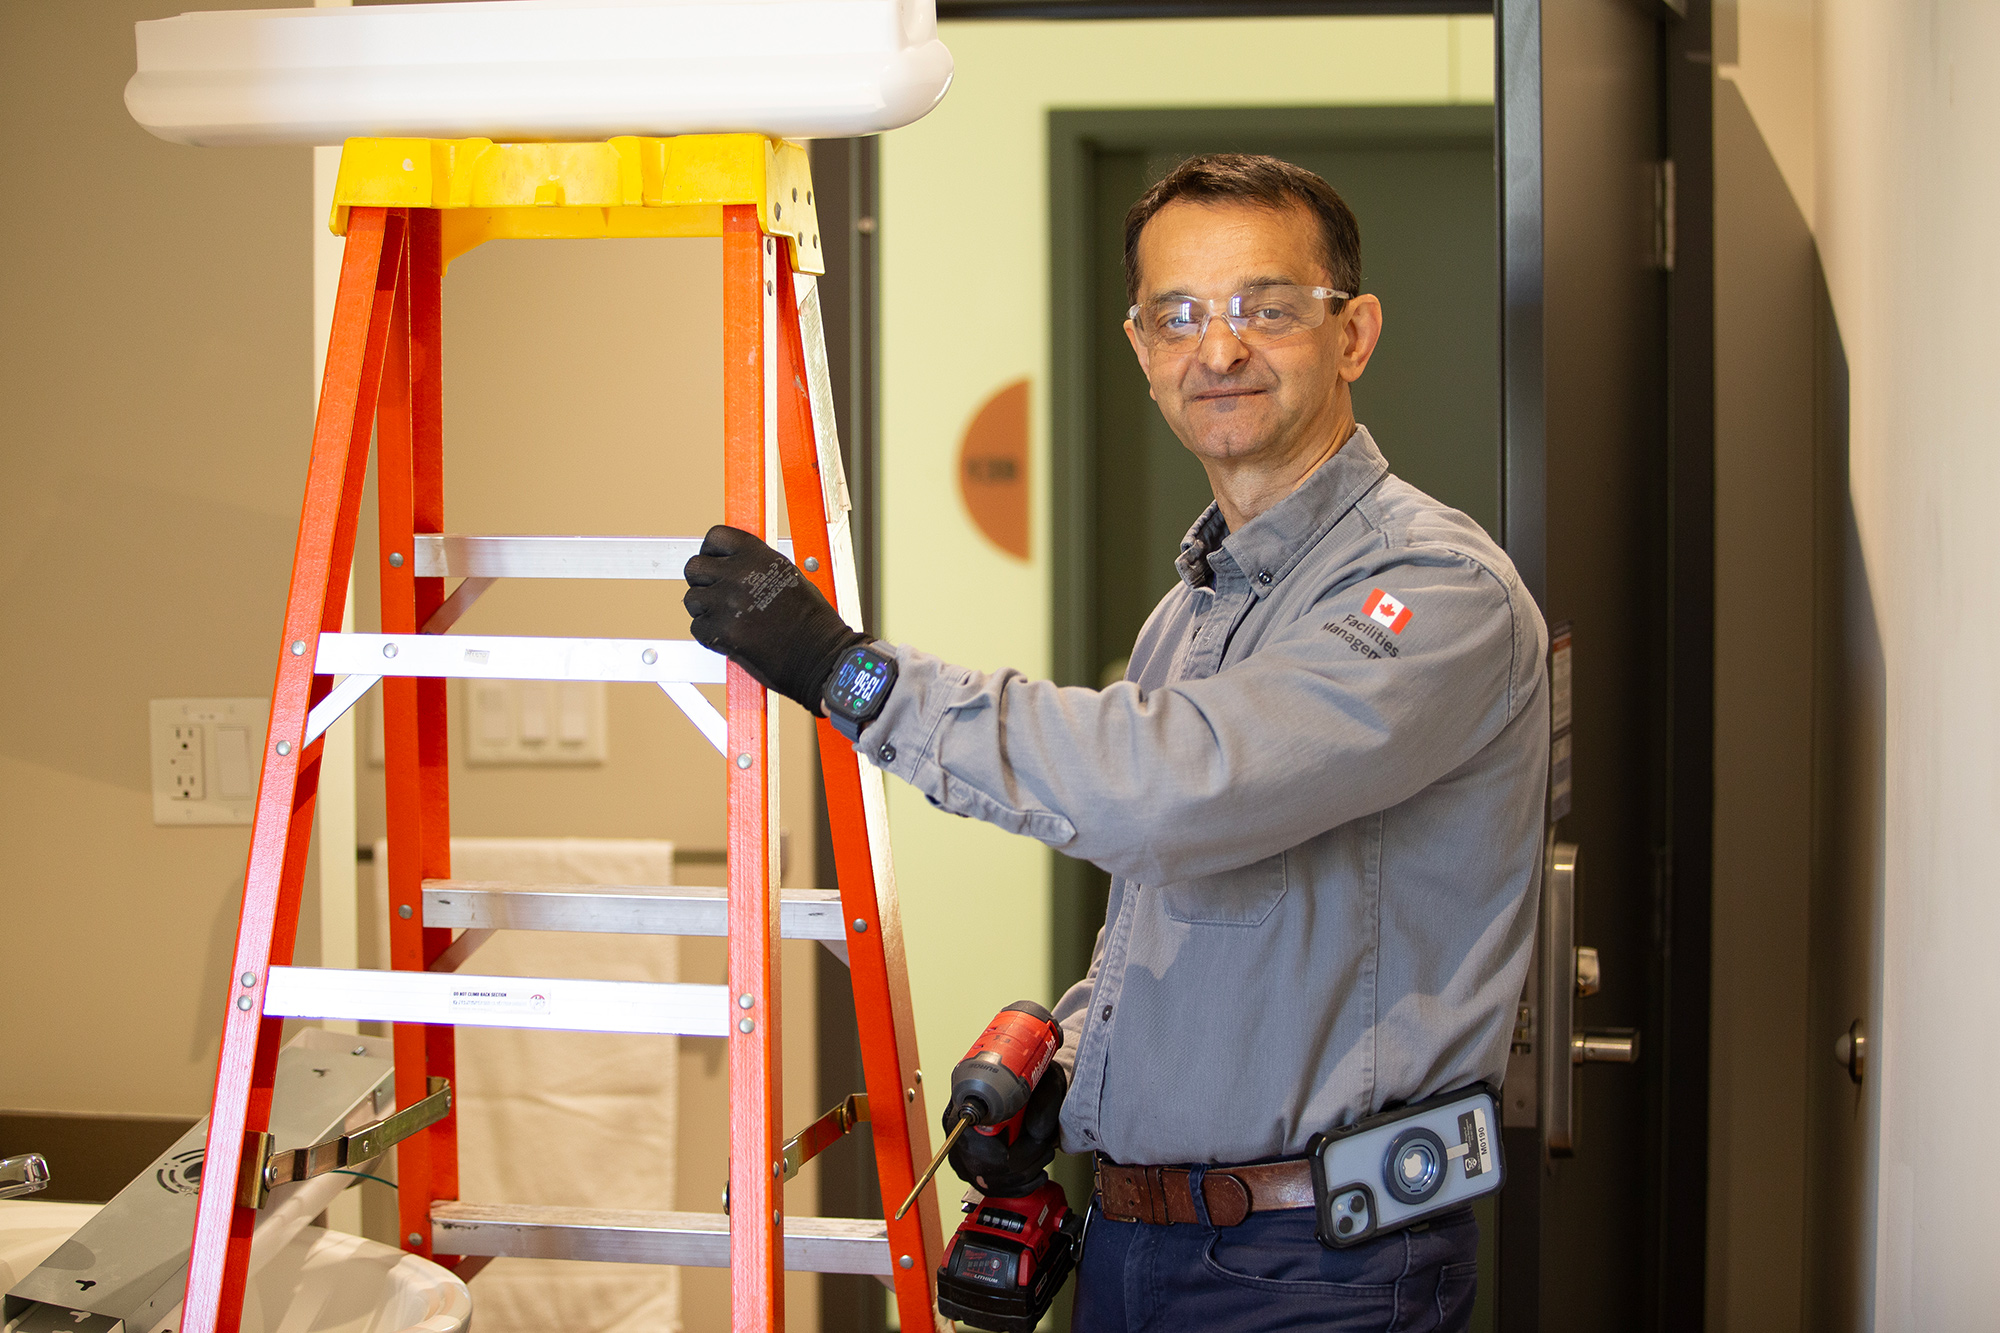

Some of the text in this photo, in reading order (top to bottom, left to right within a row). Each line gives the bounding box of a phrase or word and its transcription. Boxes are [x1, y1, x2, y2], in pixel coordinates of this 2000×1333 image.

[1321, 622, 1382, 660] Managem
[1342, 613, 1399, 658] Facilities
[849, 669, 881, 702] 13:56
[1478, 1126, 1488, 1156] M0190
